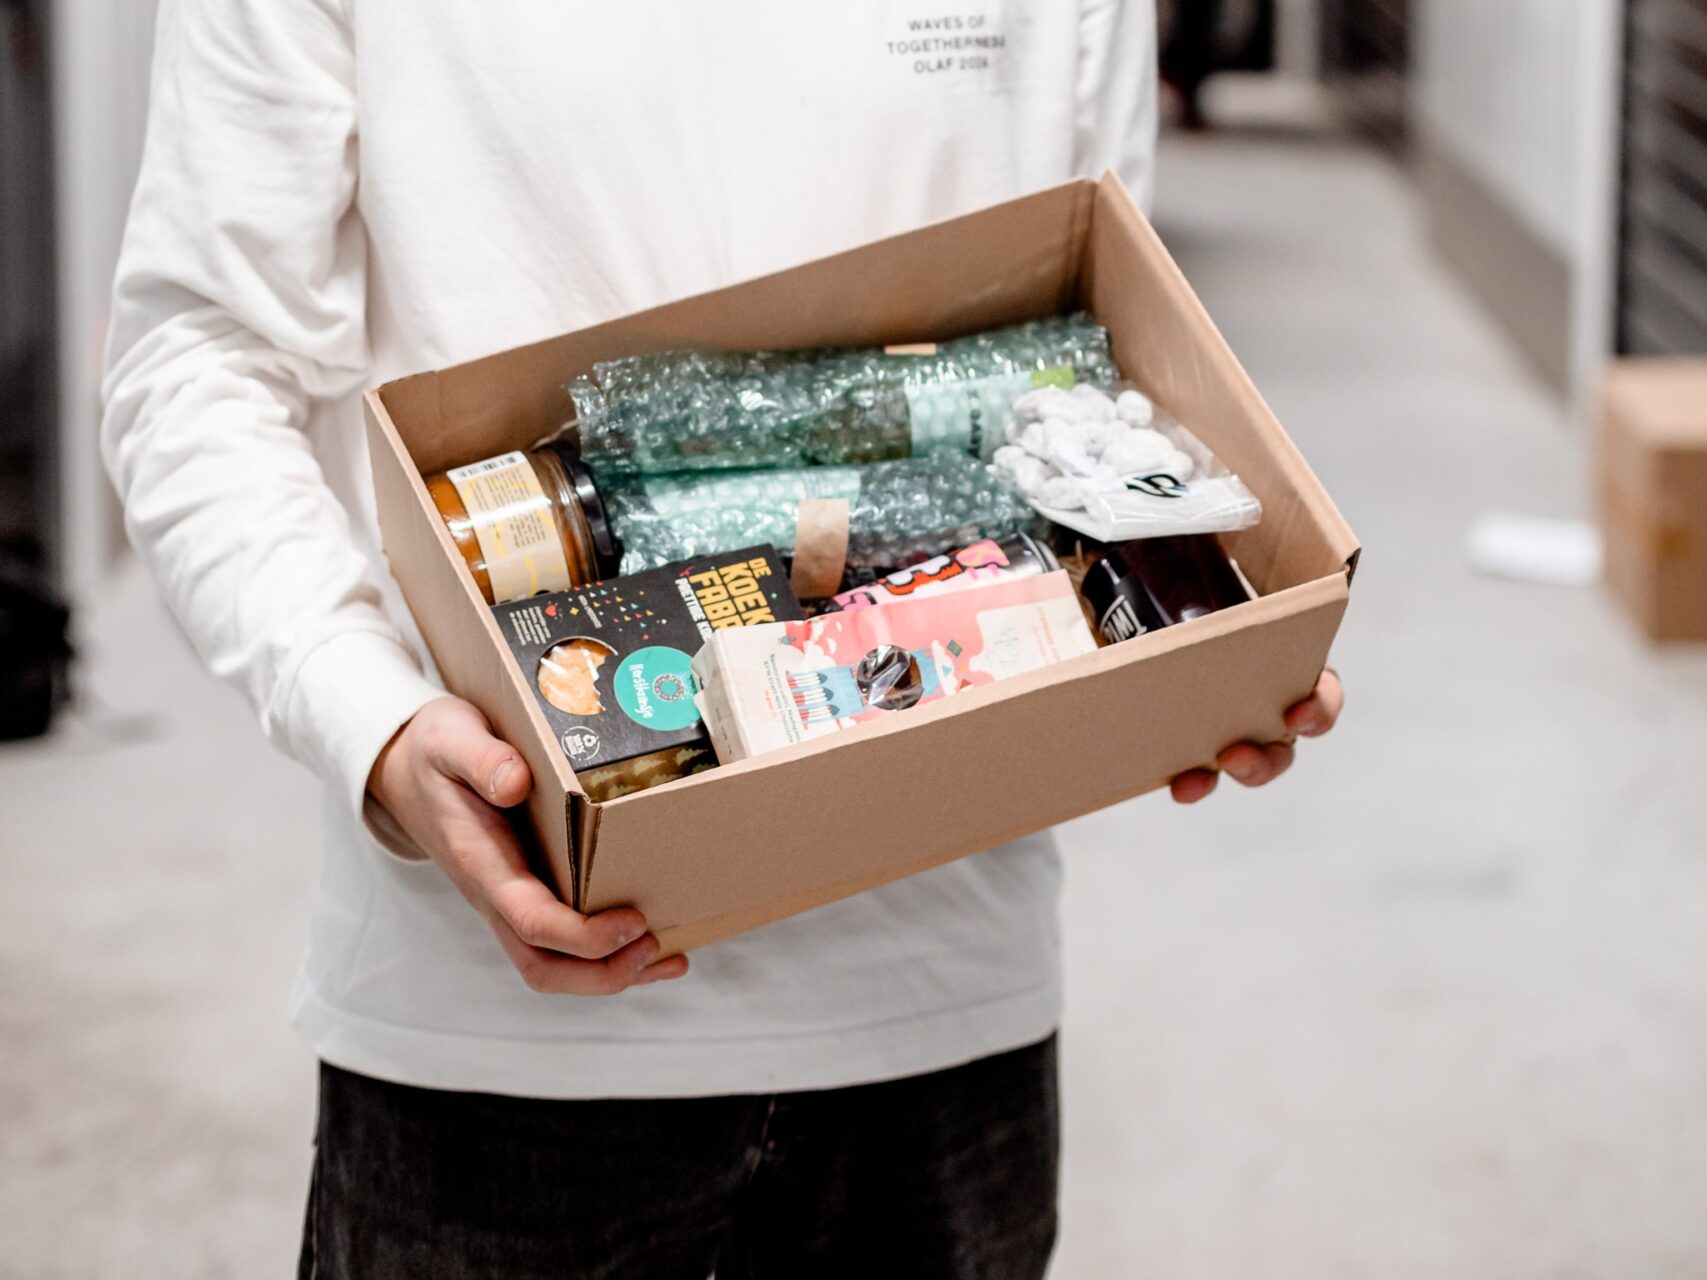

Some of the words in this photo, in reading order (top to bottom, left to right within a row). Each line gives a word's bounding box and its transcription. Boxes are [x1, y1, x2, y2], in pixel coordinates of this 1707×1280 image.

[908, 16, 963, 32] WAVES
[967, 14, 986, 29] OF
[886, 34, 1007, 56] TOGETHERNESS
[914, 57, 953, 74] OLAF
[748, 557, 772, 579] DE
[718, 562, 776, 626] KOEK
